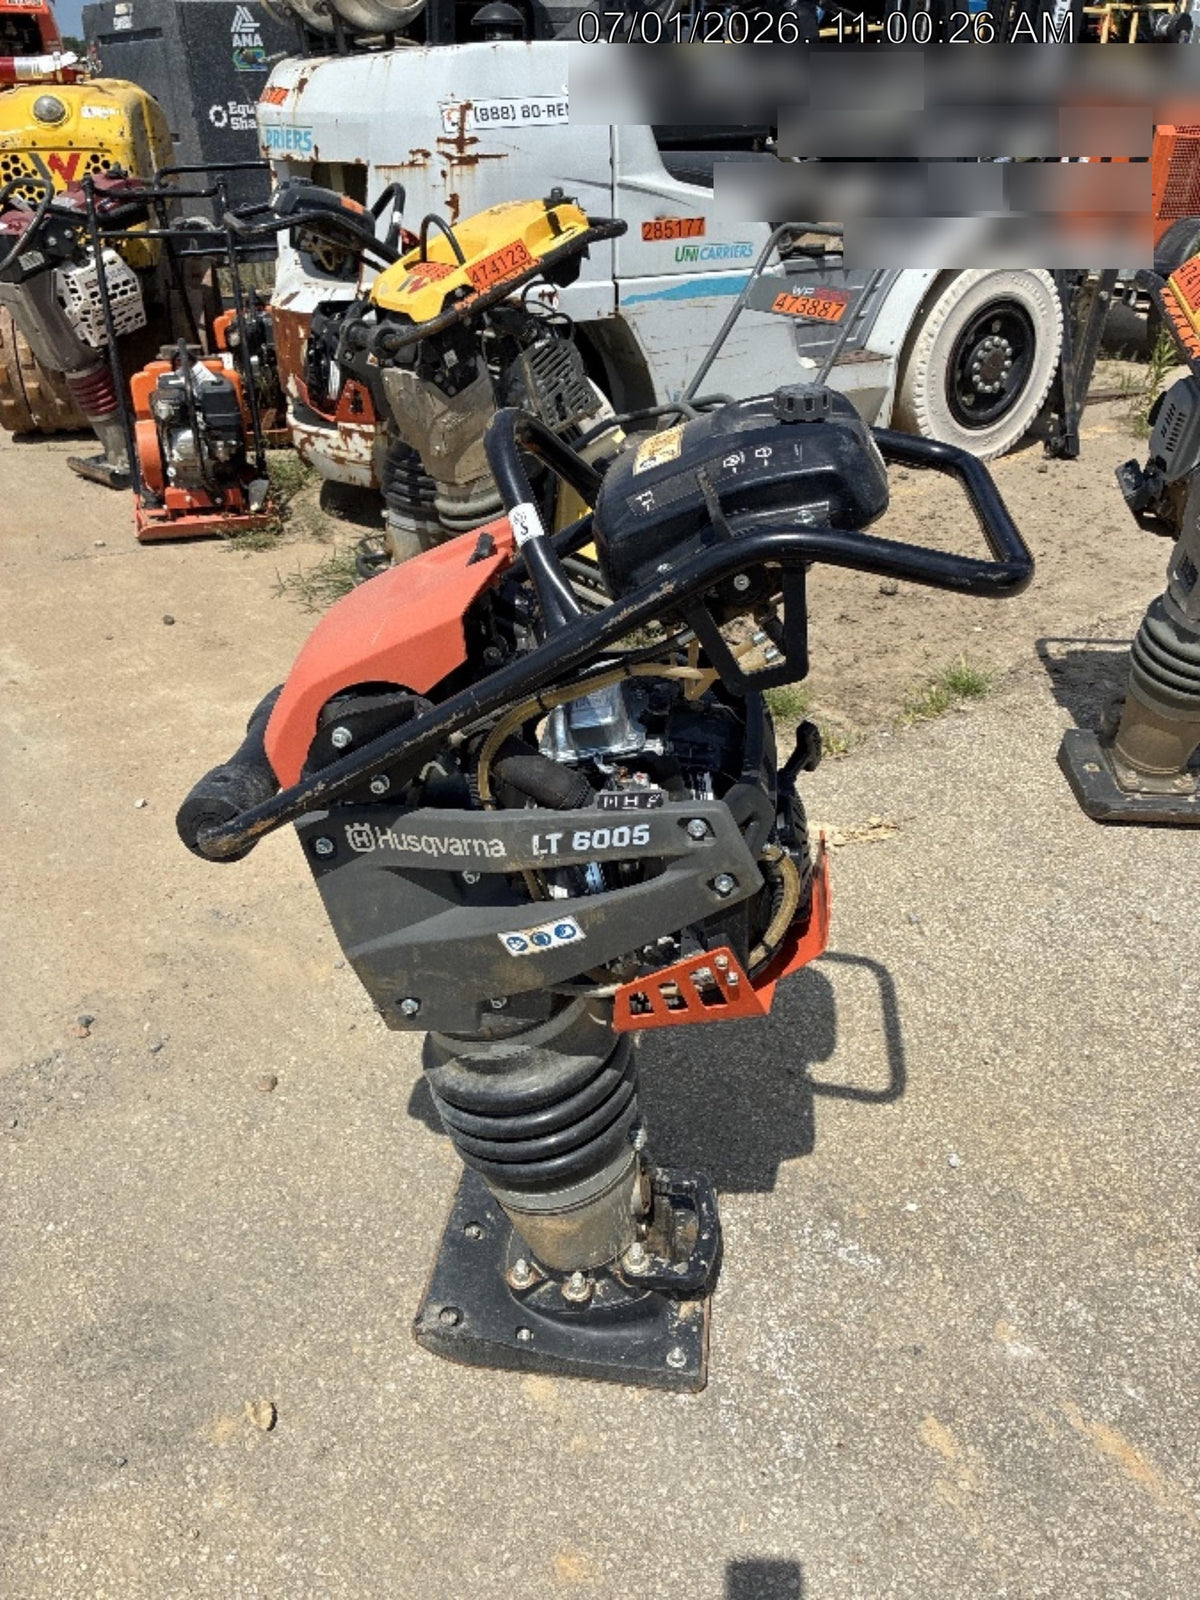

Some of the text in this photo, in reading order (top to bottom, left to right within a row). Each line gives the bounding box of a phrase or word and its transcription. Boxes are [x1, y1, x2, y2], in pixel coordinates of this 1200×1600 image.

[232, 33, 263, 47] ANA
[474, 104, 516, 123] (888)
[643, 218, 704, 240] 285177
[472, 244, 527, 286] 474123
[774, 295, 845, 319] 473887
[375, 826, 507, 858] Husqvarna
[532, 824, 651, 856] LT 6005
